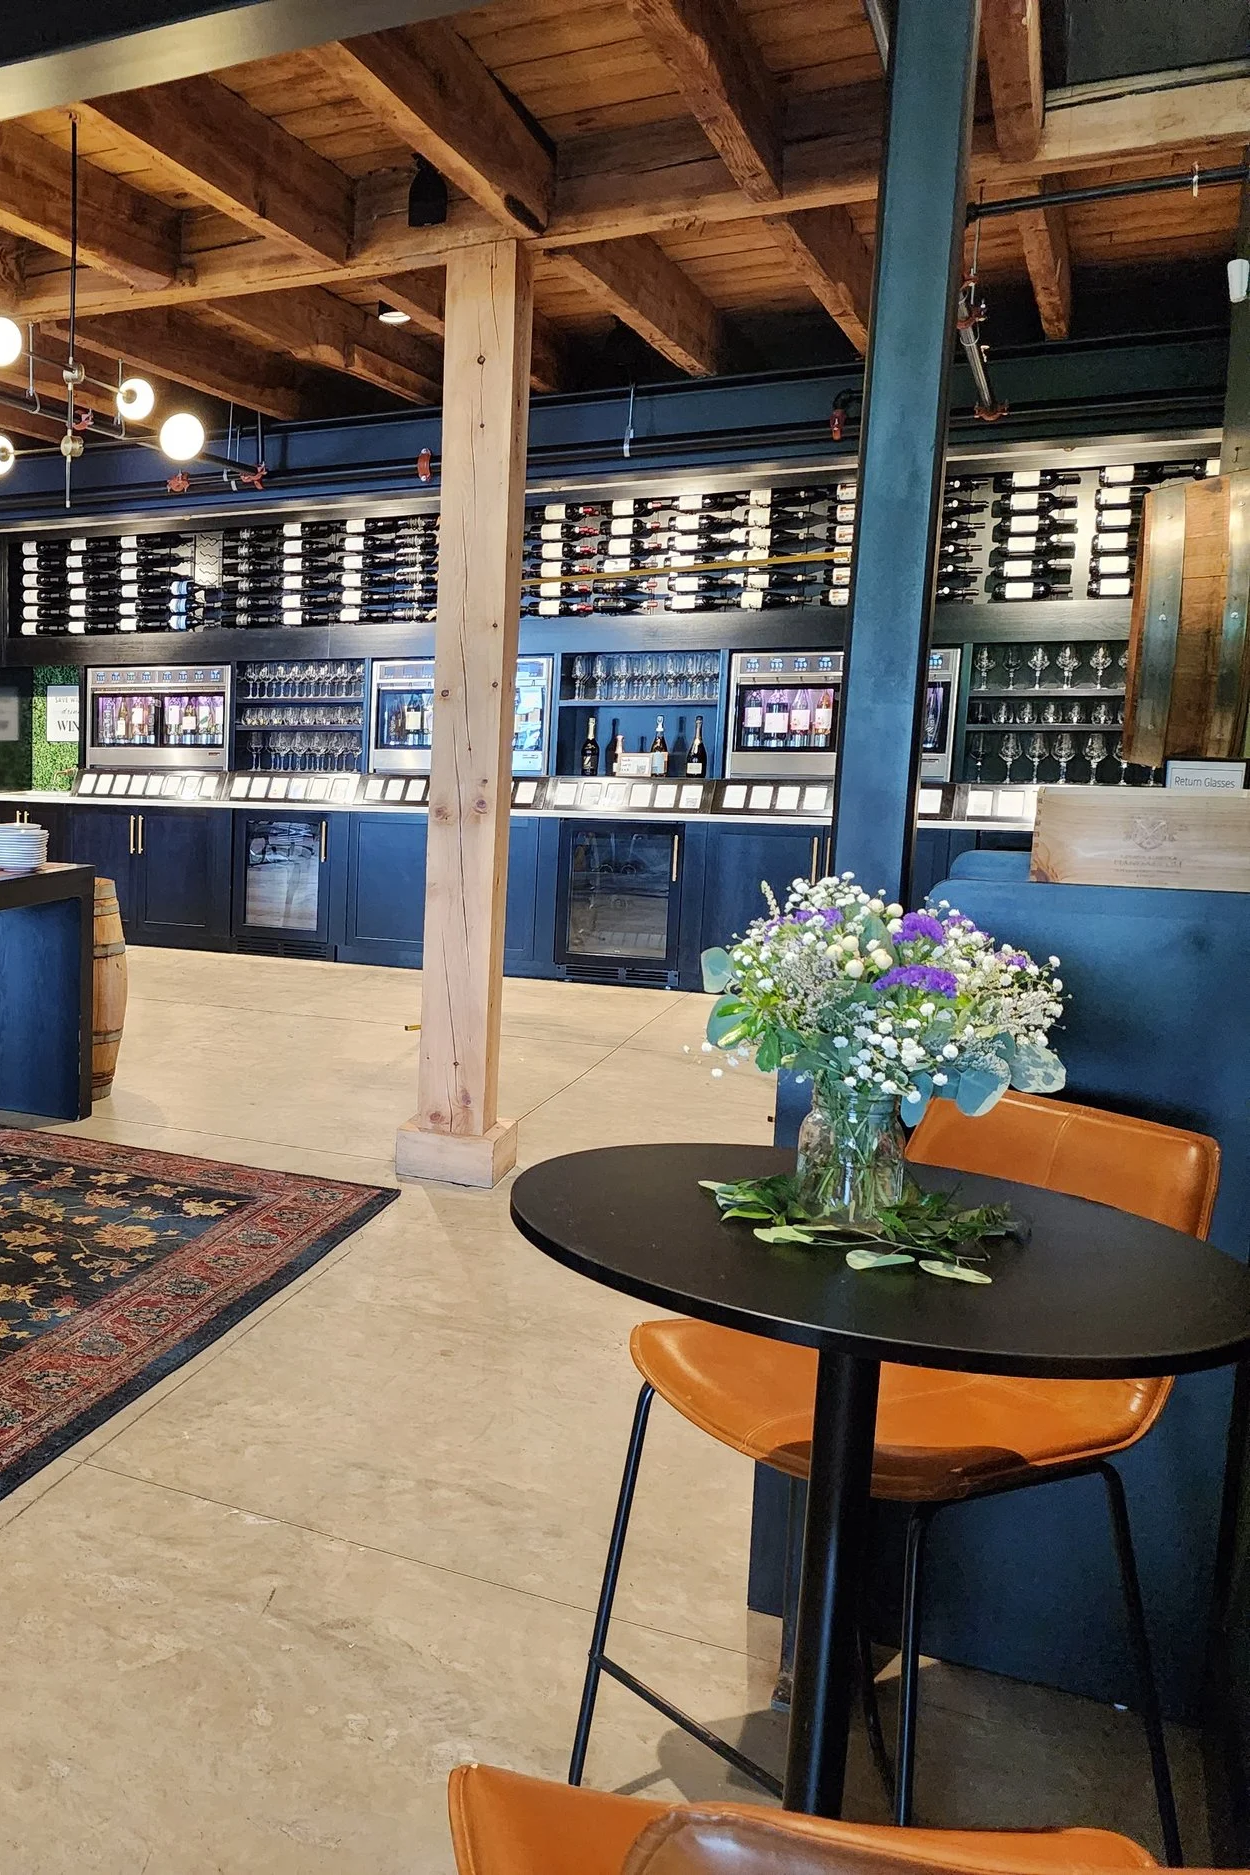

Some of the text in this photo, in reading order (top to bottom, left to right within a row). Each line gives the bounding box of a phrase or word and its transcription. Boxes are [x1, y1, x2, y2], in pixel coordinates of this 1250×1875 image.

[57, 720, 80, 731] WIN
[1174, 776, 1236, 789] Return Glasses
